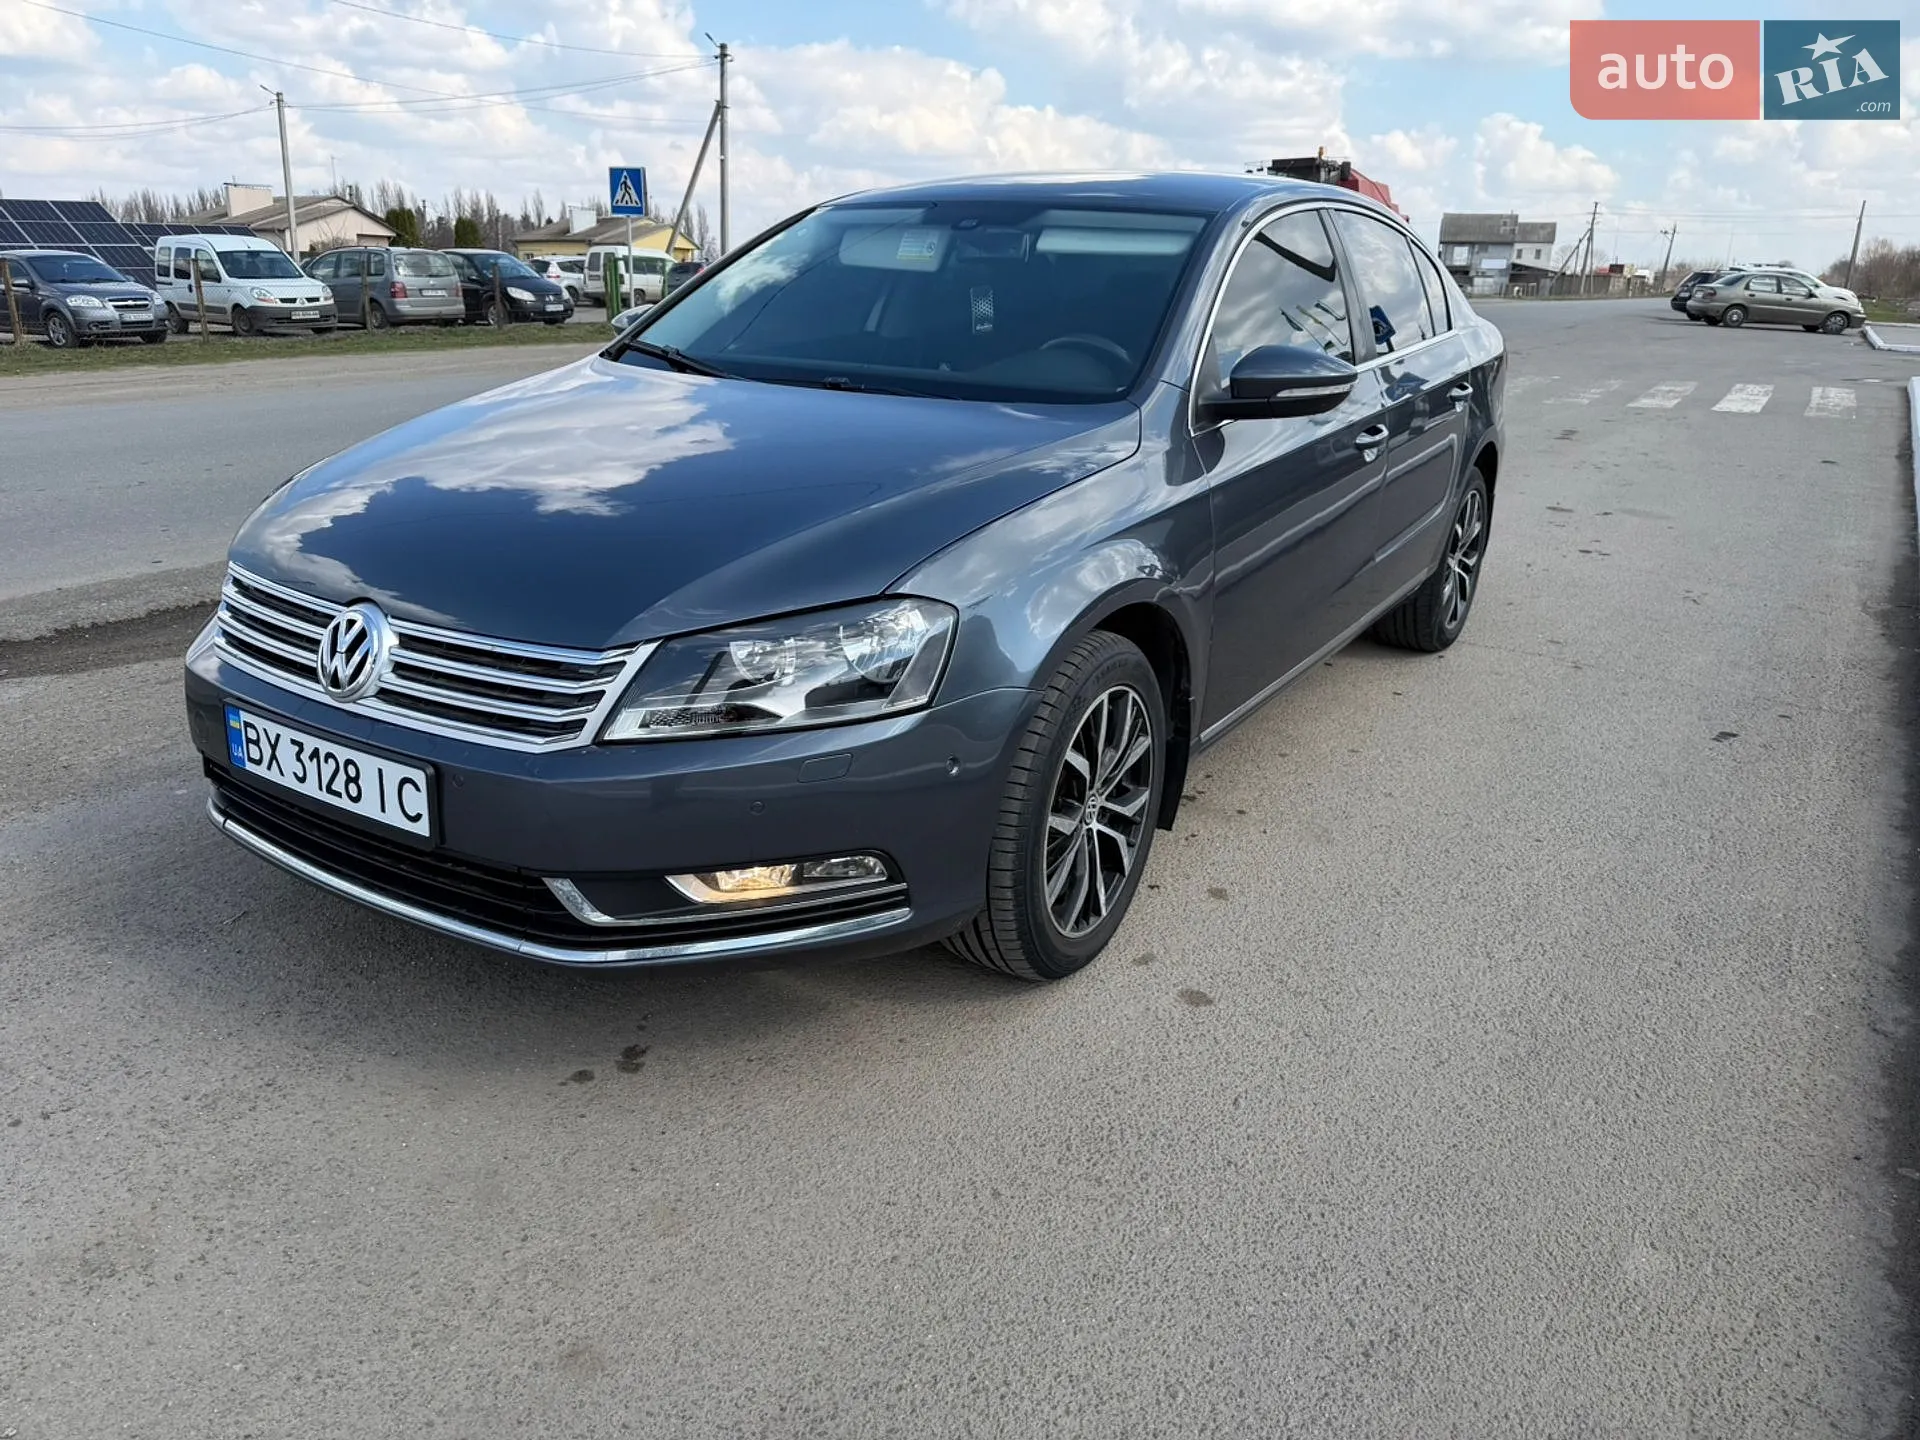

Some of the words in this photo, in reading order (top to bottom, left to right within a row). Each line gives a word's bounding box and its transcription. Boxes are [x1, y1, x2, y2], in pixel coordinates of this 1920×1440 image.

[244, 721, 285, 776] BX
[289, 738, 363, 804] 3128
[377, 767, 424, 823] IC
